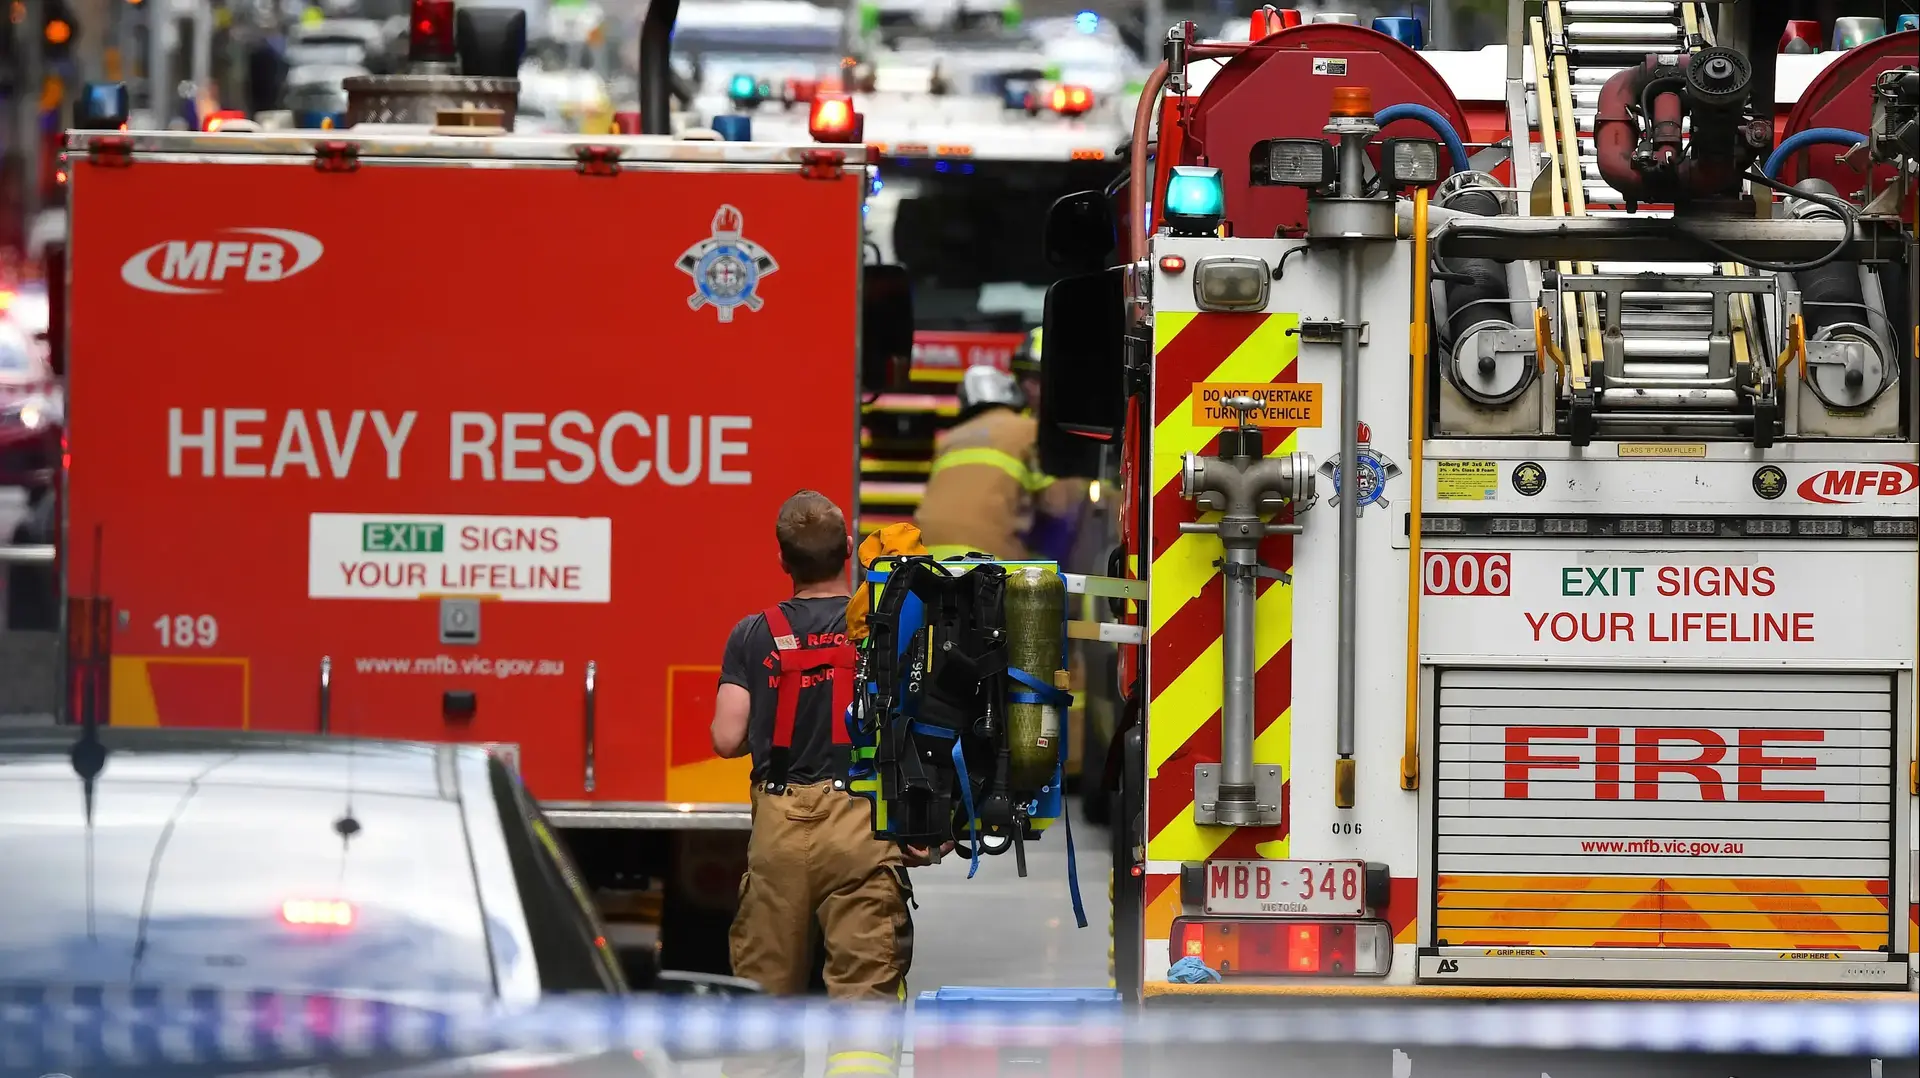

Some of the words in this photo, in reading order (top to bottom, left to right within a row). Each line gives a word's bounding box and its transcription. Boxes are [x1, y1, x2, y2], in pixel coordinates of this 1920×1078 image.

[161, 240, 285, 282] MFB
[1203, 389, 1220, 402] DO
[1252, 390, 1313, 402] OVERTAKE
[1262, 407, 1311, 420] VEHICLE
[166, 407, 418, 480] HEAVY
[449, 410, 753, 485] RESCUE
[1822, 470, 1903, 496] MFB
[365, 524, 441, 551] EXIT
[460, 526, 559, 552] SIGNS
[340, 561, 426, 587] YOUR
[441, 564, 581, 590] LIFELINE
[1426, 554, 1510, 595] 006
[1562, 567, 1644, 596] EXIT
[1657, 566, 1775, 597] SIGNS
[153, 613, 219, 648] 189
[1524, 611, 1635, 643] YOUR
[1649, 612, 1815, 643] LIFELINE
[355, 655, 565, 678] www.mfb.vic.gov.au
[1504, 726, 1825, 802] FIRE
[1331, 822, 1363, 835] 006
[1581, 839, 1744, 856] www.mfb.vic.gov.au
[1261, 902, 1309, 912] VICTORIA
[1809, 952, 1830, 960] HERE
